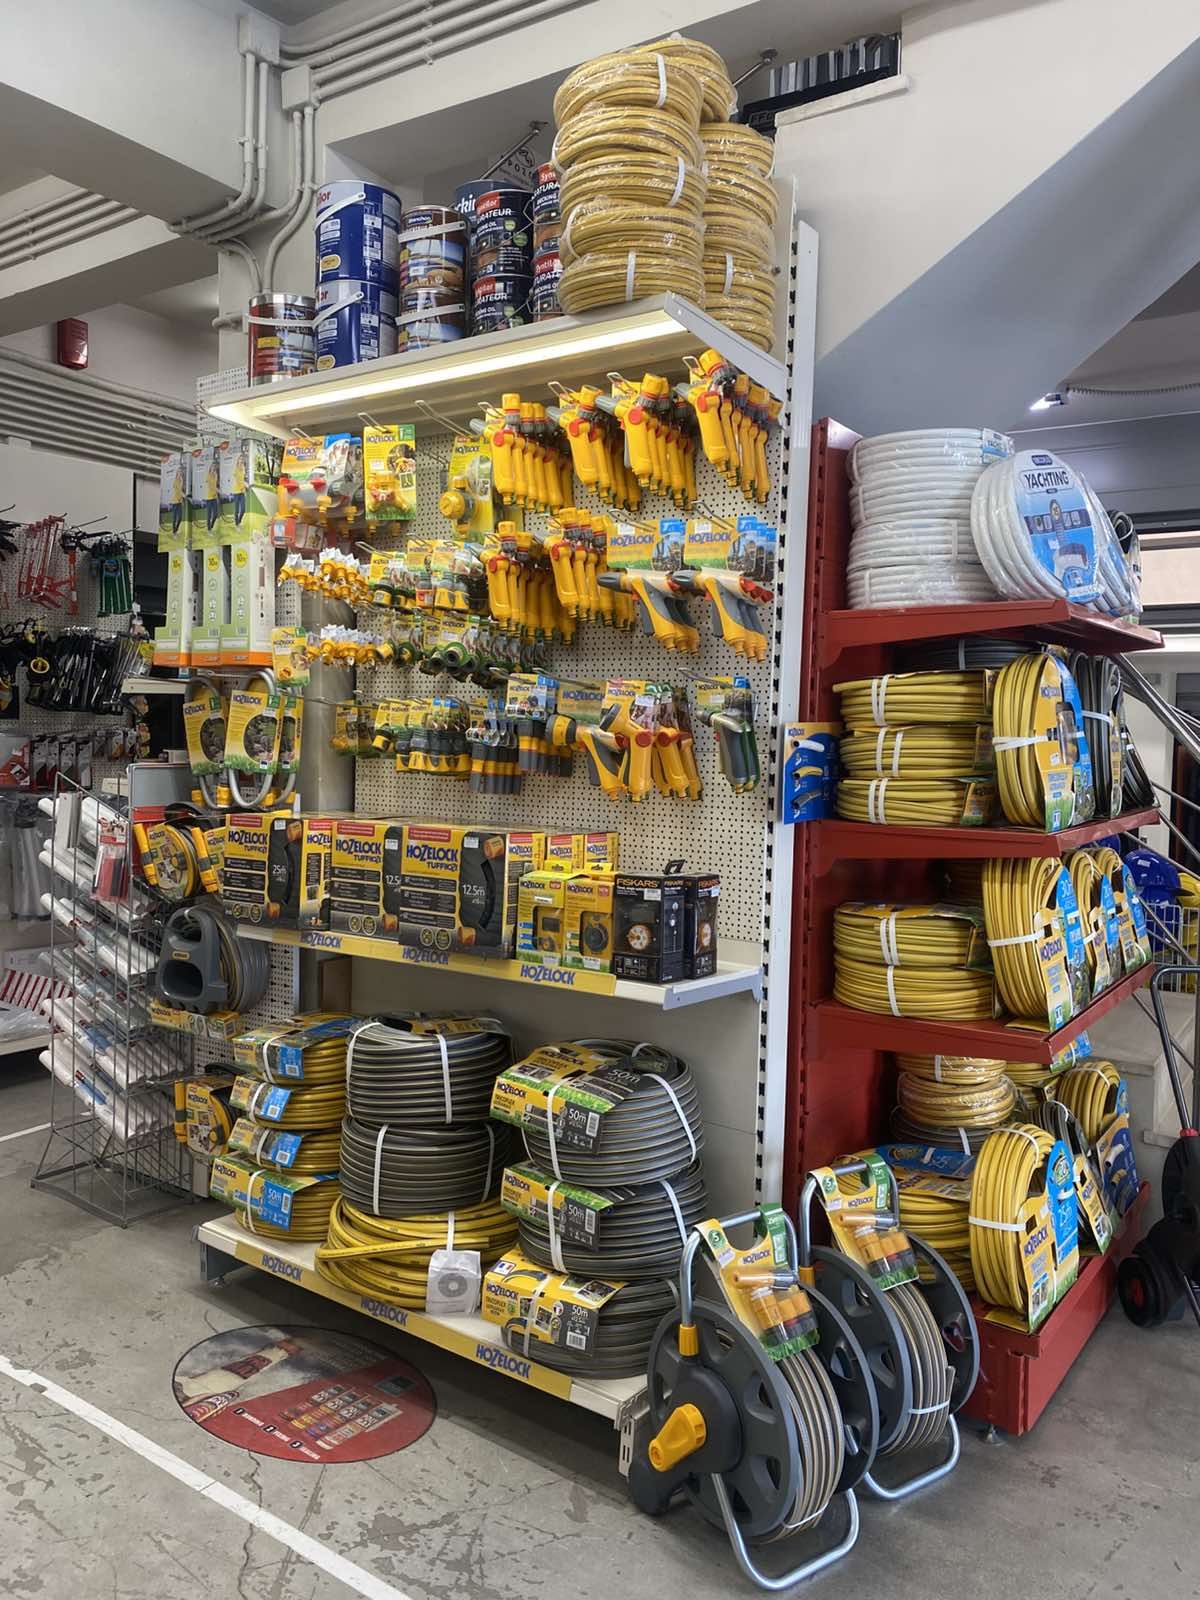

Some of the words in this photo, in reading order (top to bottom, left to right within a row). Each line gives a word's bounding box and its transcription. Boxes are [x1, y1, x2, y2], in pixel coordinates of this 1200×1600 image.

[1024, 471, 1069, 489] YACHTING
[610, 535, 654, 546] HOZELOCK
[688, 532, 731, 543] HOZELOCK
[228, 830, 269, 845] HOZELOCK
[307, 832, 331, 845] HOZEL
[336, 839, 382, 855] HOZELOCK
[406, 844, 458, 862] HOZELOCK
[616, 879, 658, 888] FISKARS
[402, 947, 449, 965] HOZELOCK
[520, 965, 576, 985] HOZELOCK
[568, 1108, 587, 1123] 50m
[262, 1255, 303, 1281] HOZELOCK
[486, 1283, 519, 1301] HOZELOCK
[360, 1296, 408, 1327] HOZELOCK
[572, 1304, 589, 1318] 50m
[476, 1344, 530, 1379] HOZELOCK
